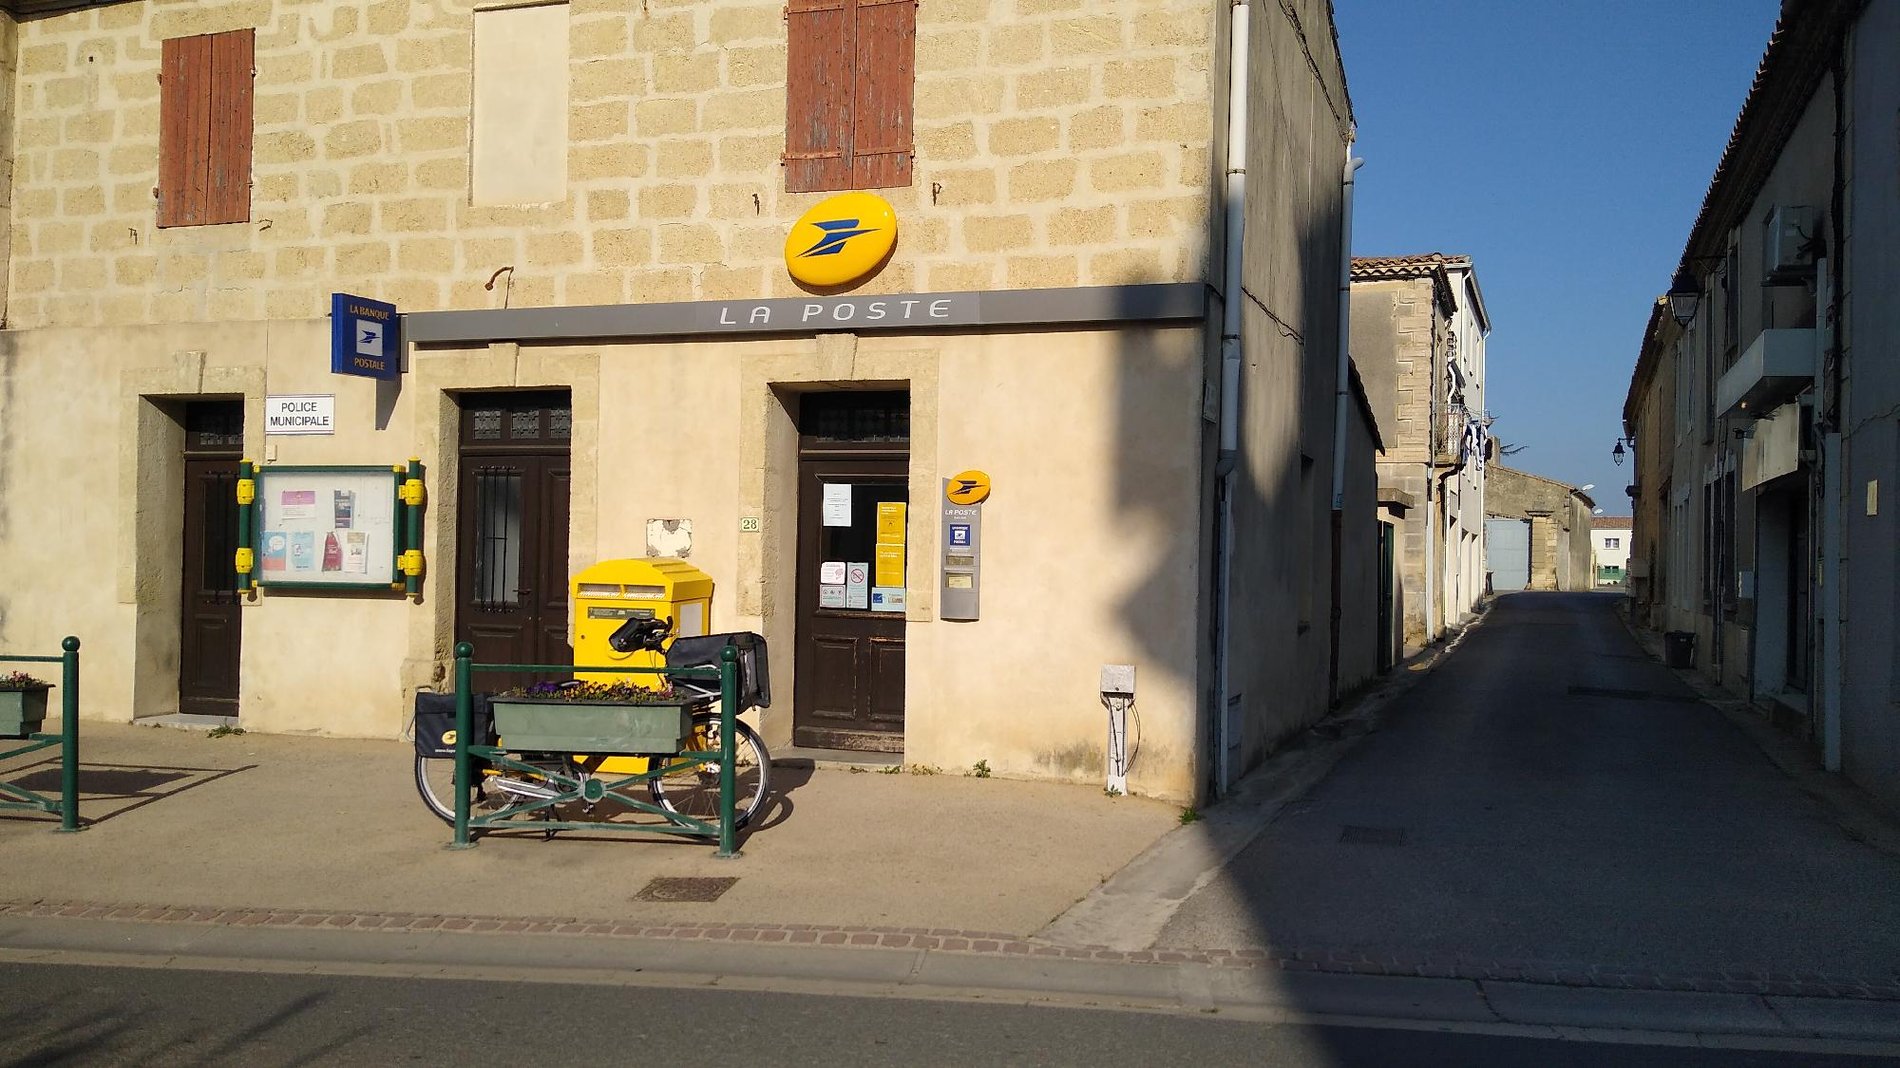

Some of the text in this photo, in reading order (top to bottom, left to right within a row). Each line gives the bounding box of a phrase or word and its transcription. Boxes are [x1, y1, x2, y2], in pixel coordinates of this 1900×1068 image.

[349, 304, 390, 320] LA BANQUE
[720, 299, 952, 325] LA POSTE
[354, 357, 385, 371] POSTALE
[281, 401, 318, 413] POLICE
[270, 415, 330, 427] MUNICIPALE
[743, 519, 757, 530] 28
